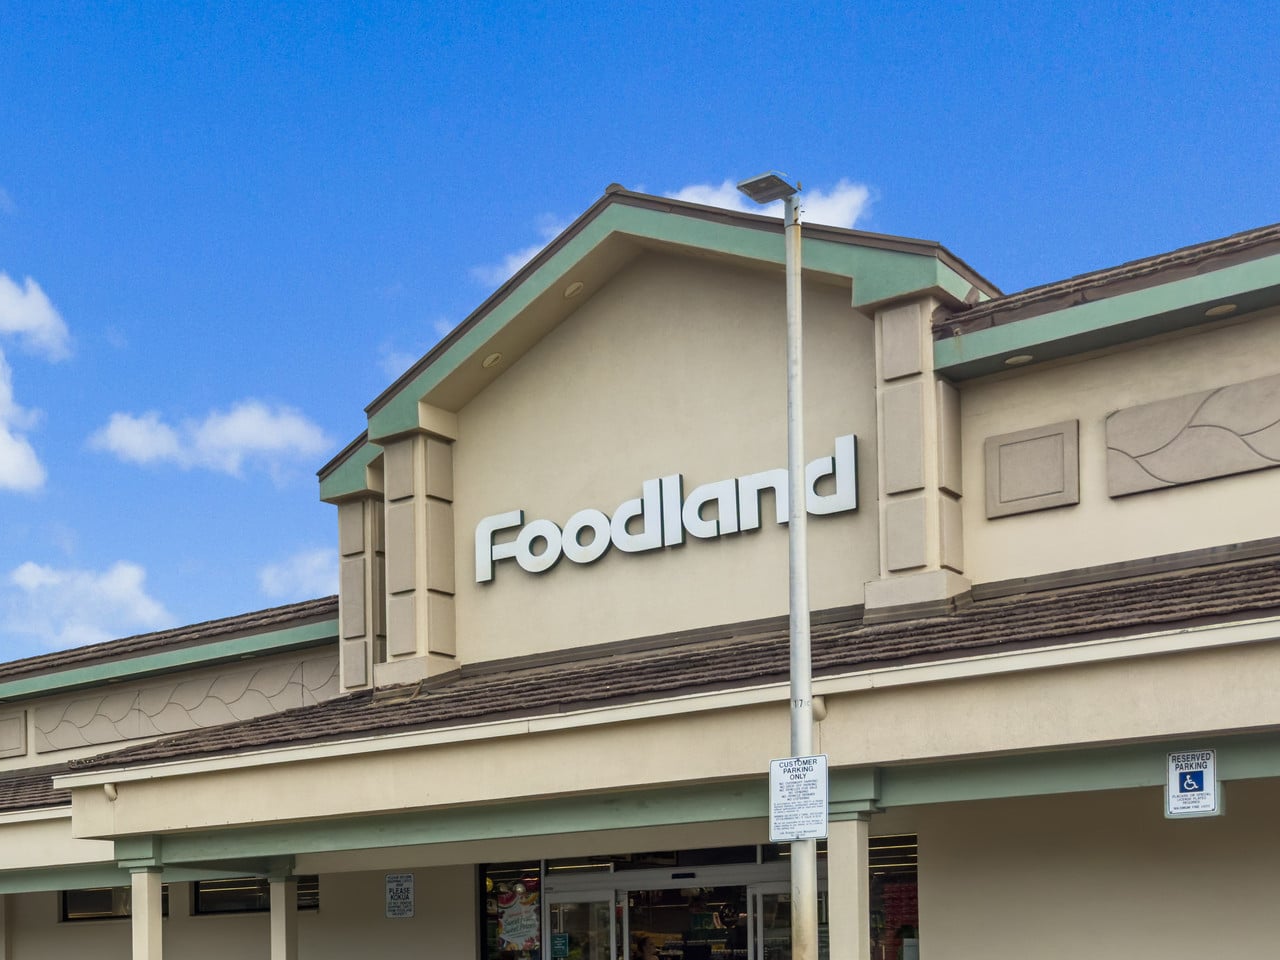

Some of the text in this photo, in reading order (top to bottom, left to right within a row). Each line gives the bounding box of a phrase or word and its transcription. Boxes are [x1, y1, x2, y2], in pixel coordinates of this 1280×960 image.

[475, 434, 859, 583] Foodland
[779, 758, 818, 768] CUSTOMER
[1172, 753, 1211, 763] RESERVED
[783, 766, 814, 774] PARKING
[1175, 761, 1208, 771] PARKING
